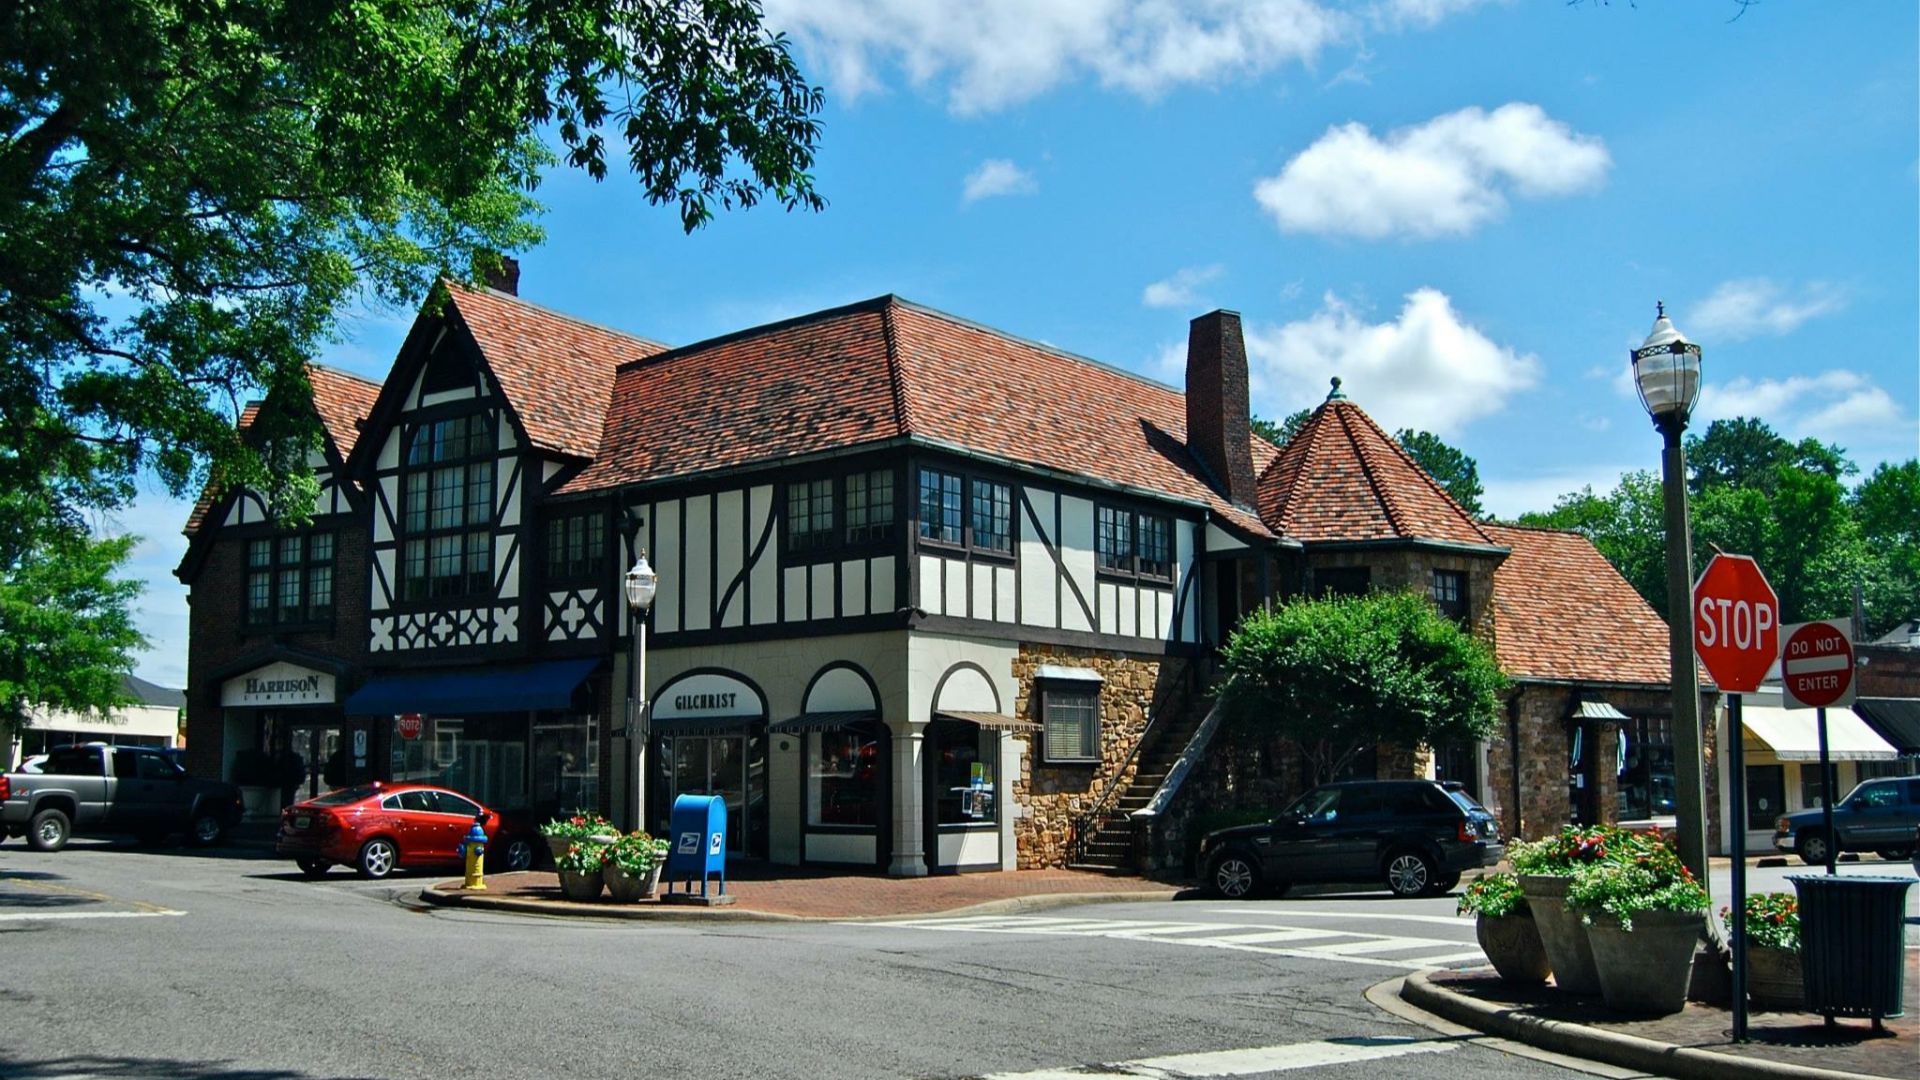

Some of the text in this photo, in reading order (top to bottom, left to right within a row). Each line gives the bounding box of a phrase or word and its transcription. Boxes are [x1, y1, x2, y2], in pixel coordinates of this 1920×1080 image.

[1699, 596, 1773, 650] STOP
[1791, 637, 1841, 654] DO NOT
[1799, 675, 1839, 691] ENTER
[675, 692, 736, 710] GILCHRIST
